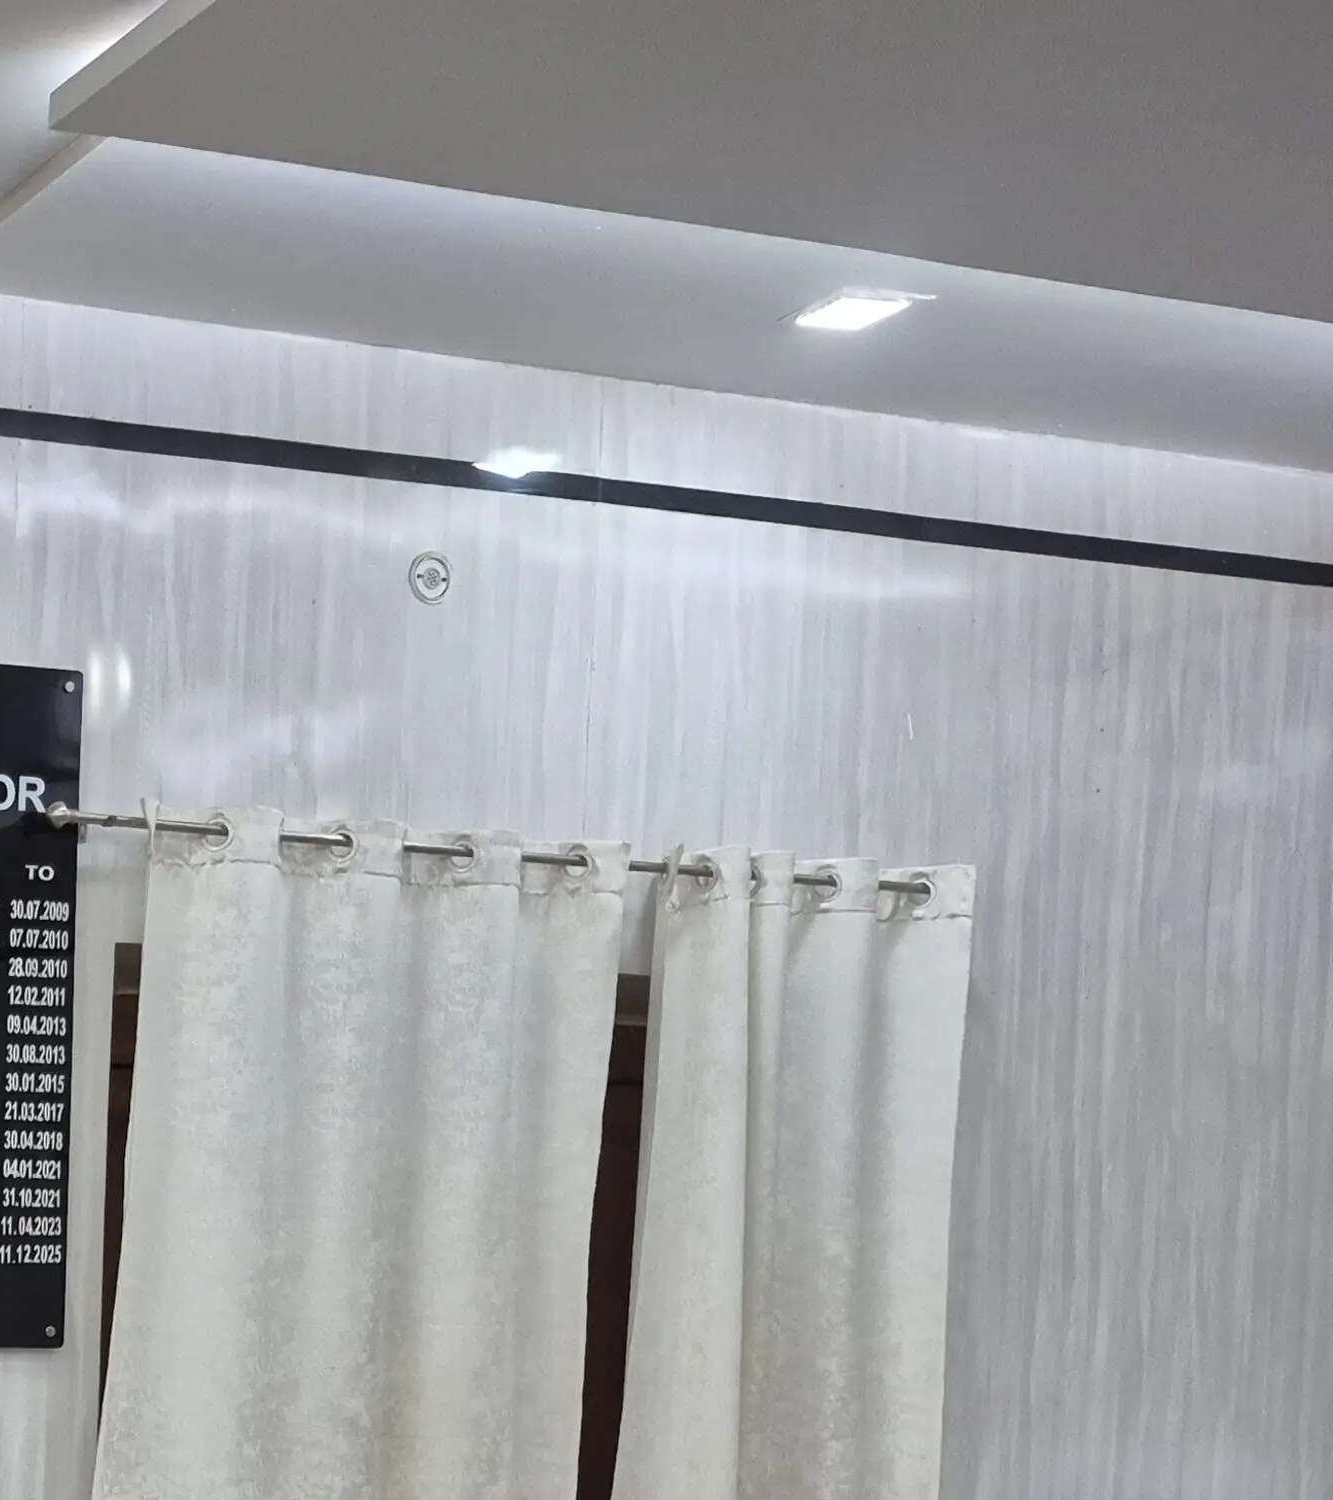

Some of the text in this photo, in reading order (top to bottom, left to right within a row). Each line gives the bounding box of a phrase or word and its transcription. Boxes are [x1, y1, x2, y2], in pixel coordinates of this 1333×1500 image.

[25, 864, 55, 881] TO
[10, 898, 68, 920] 30.07.2009
[9, 927, 68, 949] 07.07.2010
[7, 984, 65, 1006] 12.02.2011
[6, 1014, 65, 1035] 09.04.2013
[5, 1043, 64, 1064] 30.08.2013
[4, 1100, 63, 1121] 21.03.2017
[3, 1129, 62, 1150] 30.04.2018
